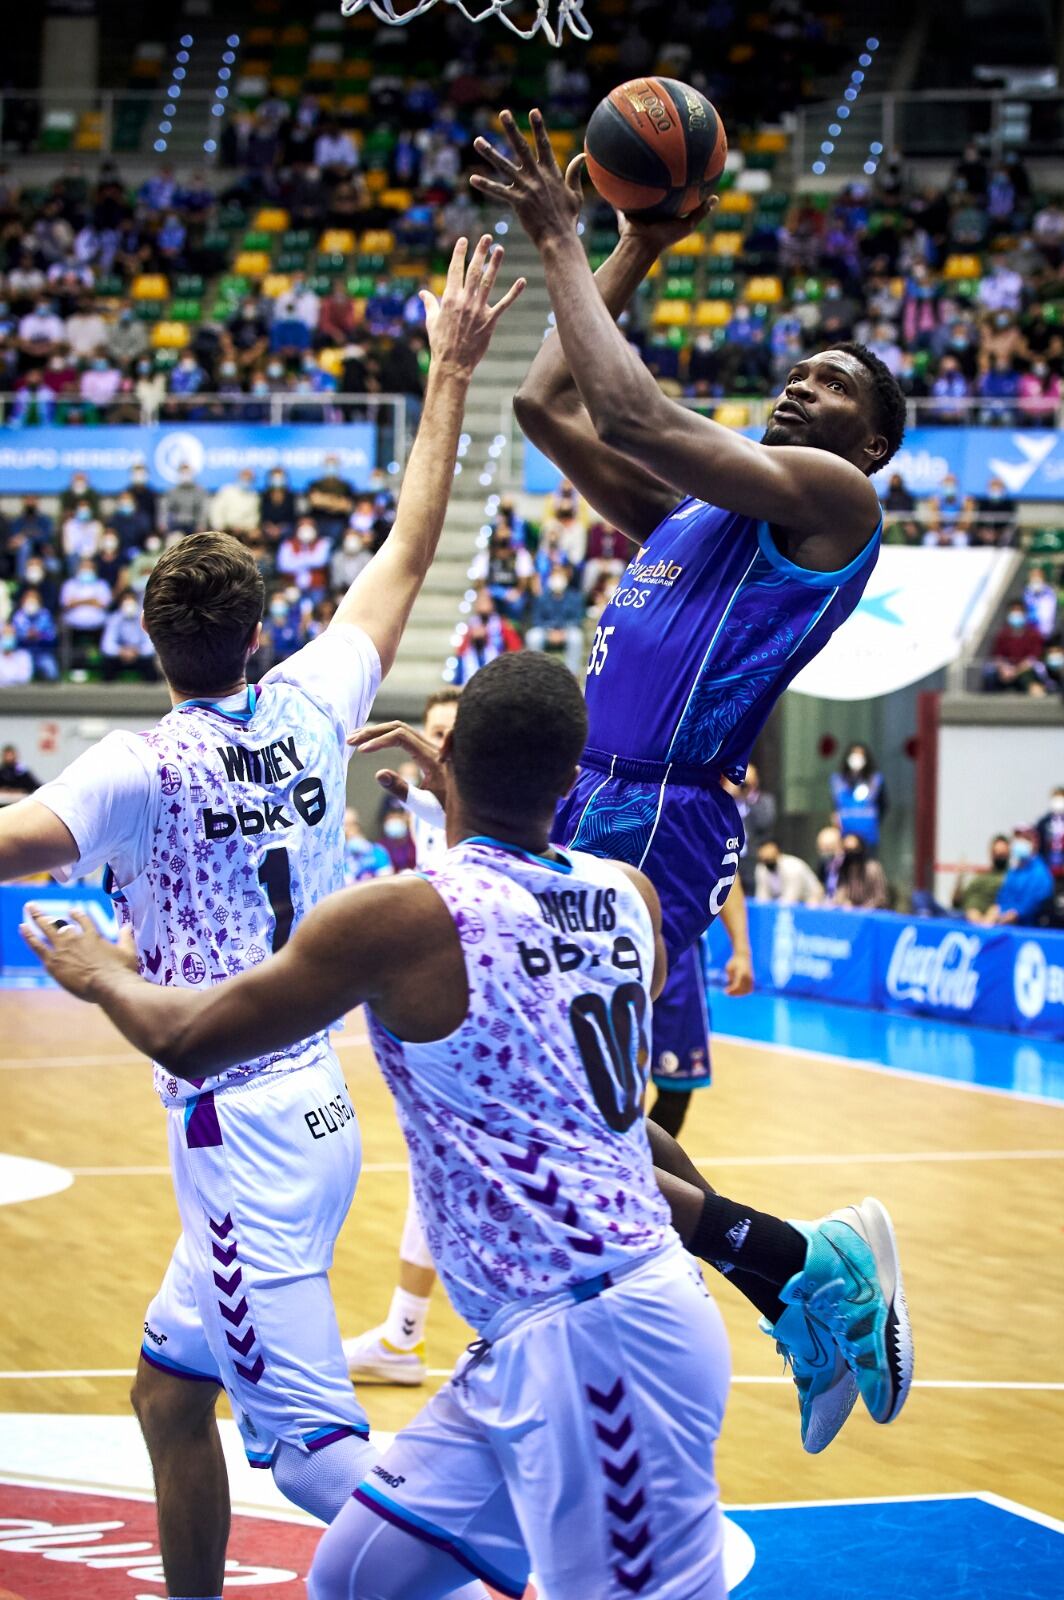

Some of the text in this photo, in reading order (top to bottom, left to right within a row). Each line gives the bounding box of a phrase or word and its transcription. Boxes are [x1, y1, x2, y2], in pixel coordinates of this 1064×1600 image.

[638, 88, 672, 131] 1000
[216, 736, 304, 784] WITHEY
[203, 800, 294, 840] bbk
[258, 846, 295, 954] 1
[517, 936, 601, 978] bb
